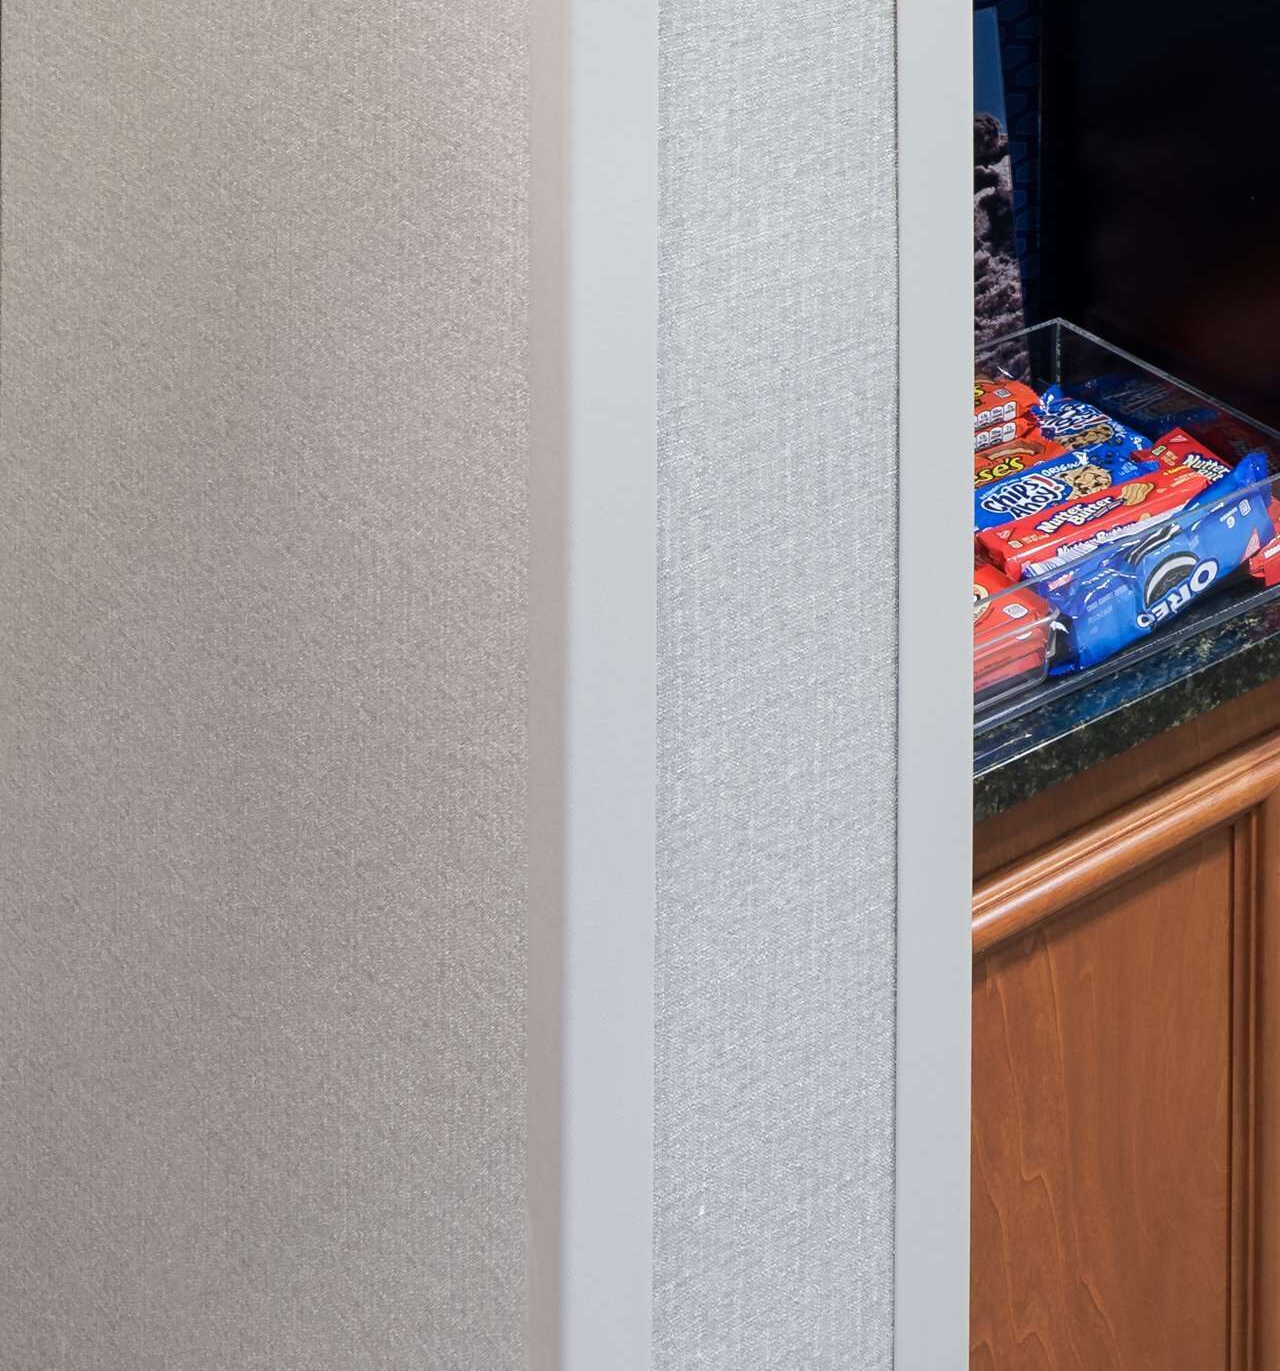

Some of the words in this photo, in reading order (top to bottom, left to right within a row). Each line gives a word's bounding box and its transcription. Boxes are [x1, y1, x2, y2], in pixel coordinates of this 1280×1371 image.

[1185, 453, 1231, 474] Nutter
[982, 479, 1040, 513] Chips
[1070, 496, 1112, 527] Butter
[1036, 502, 1083, 534] Nutter
[1136, 557, 1220, 629] OREO
